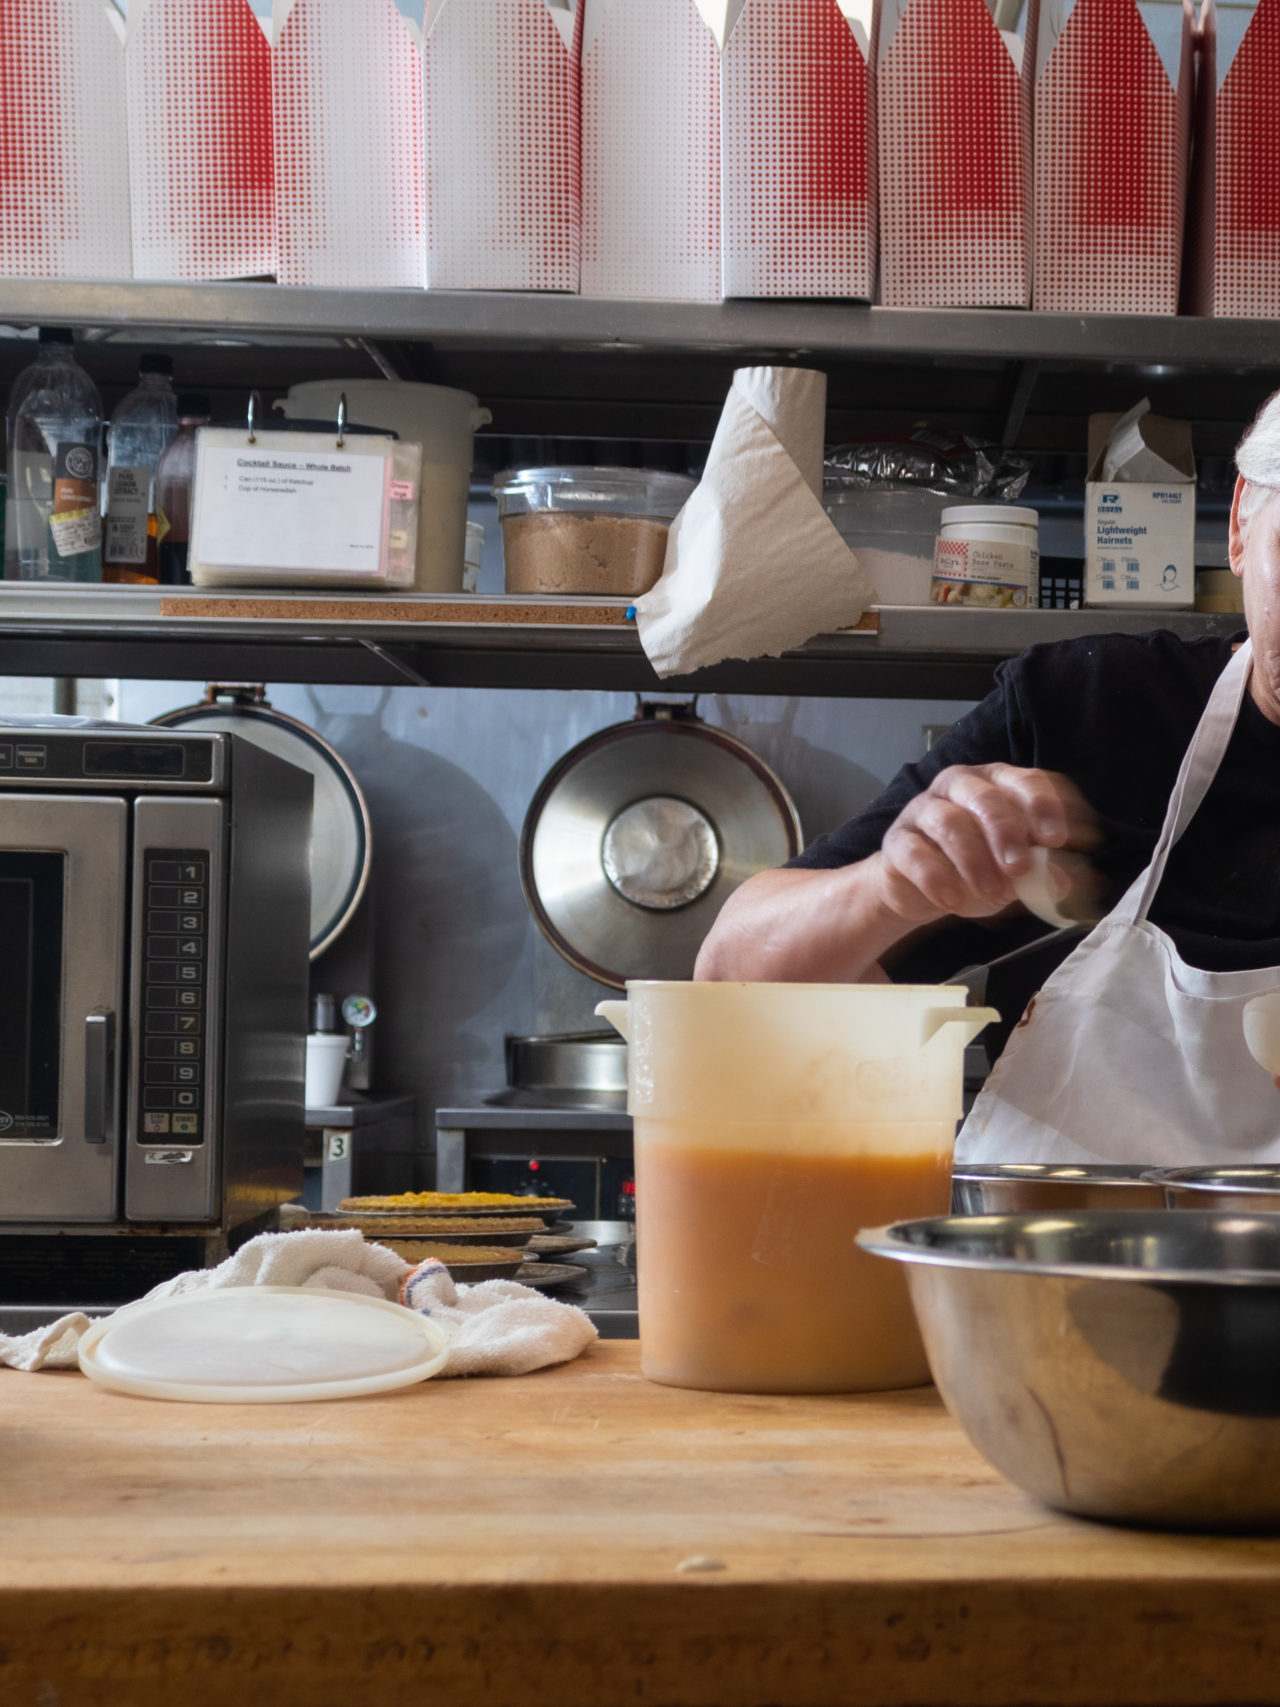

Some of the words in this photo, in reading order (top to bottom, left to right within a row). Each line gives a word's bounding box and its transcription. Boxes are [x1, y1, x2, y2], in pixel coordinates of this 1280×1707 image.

[237, 458, 271, 469] Cocktail
[272, 460, 297, 470] Sauce
[306, 462, 329, 471] Whole
[330, 463, 352, 473] Batch
[289, 478, 314, 486] Ketchup
[1097, 526, 1147, 536] Lightweight
[1097, 536, 1133, 545] Hairnets
[972, 551, 1003, 560] Chicken
[993, 560, 1014, 568] Paste
[185, 866, 196, 879] 1
[183, 891, 198, 903] 2
[183, 917, 197, 929] 3
[182, 942, 197, 954] 4
[181, 967, 196, 979] 5
[181, 992, 195, 1004] 6
[180, 1017, 195, 1029] 7
[180, 1042, 194, 1054] 8
[179, 1067, 194, 1080] 9
[178, 1092, 193, 1104] 0
[332, 1138, 345, 1157] 3
